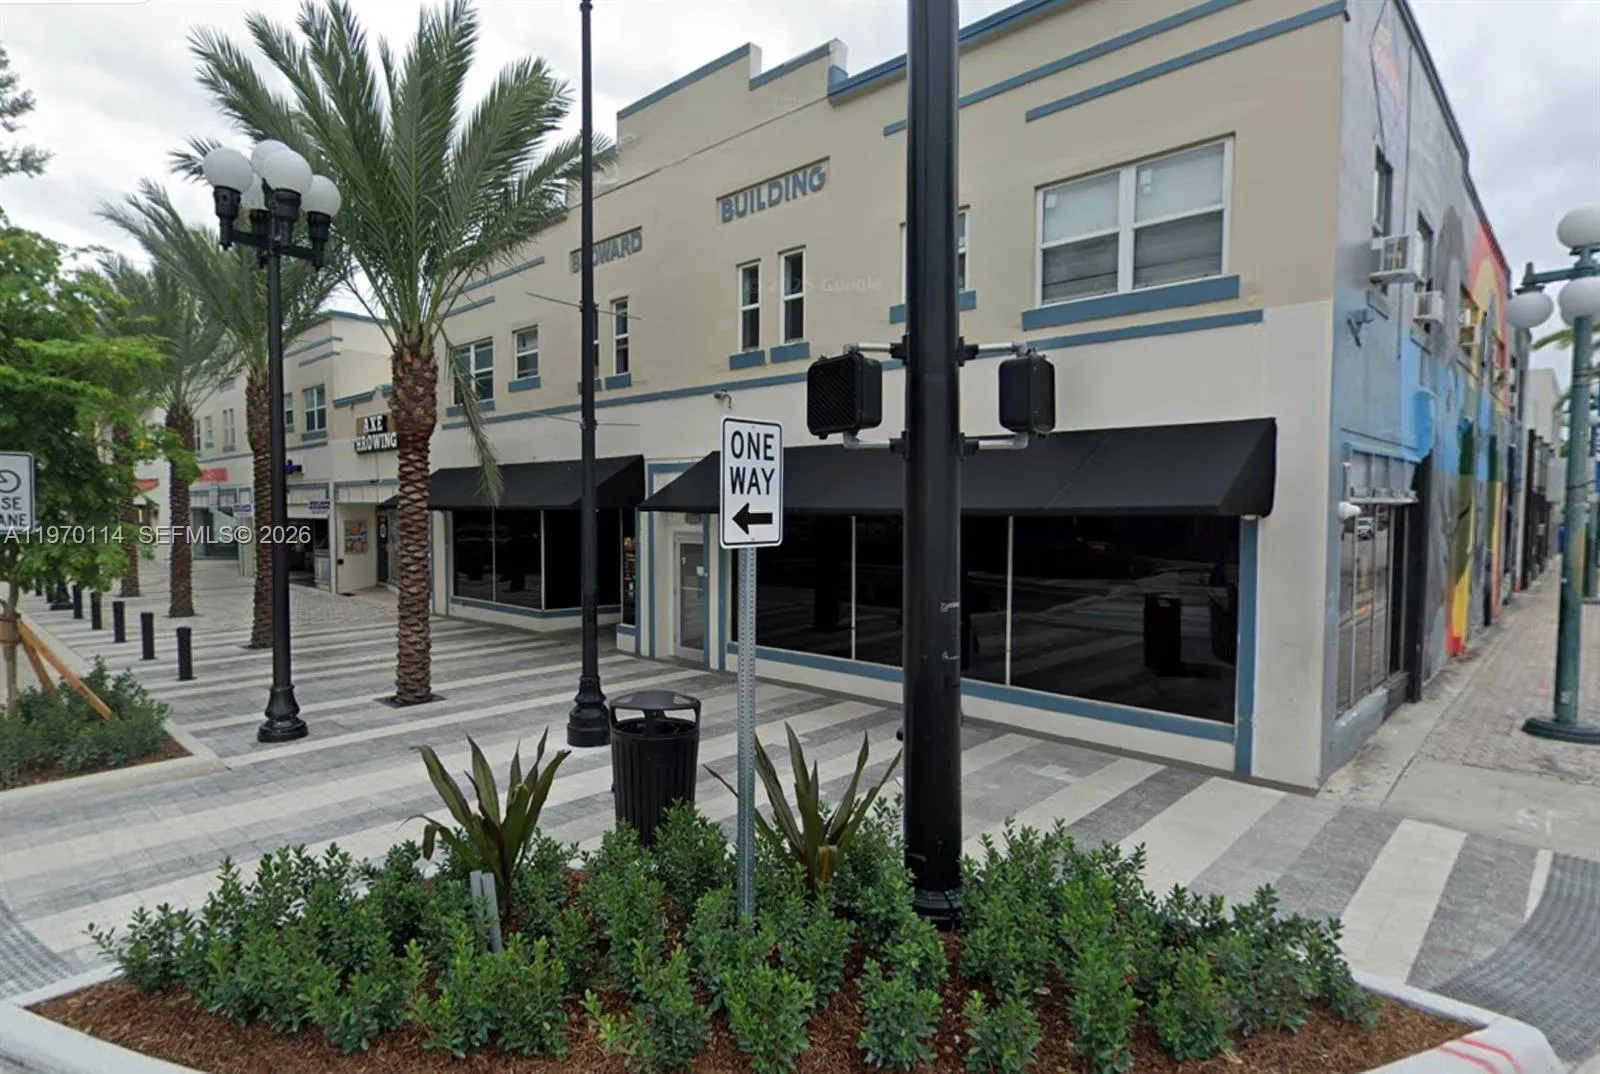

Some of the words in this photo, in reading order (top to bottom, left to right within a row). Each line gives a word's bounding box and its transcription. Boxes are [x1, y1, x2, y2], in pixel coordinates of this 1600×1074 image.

[720, 165, 826, 223] BUILDING
[362, 415, 383, 433] AXE
[730, 429, 775, 461] ONE
[729, 466, 775, 495] WAY
